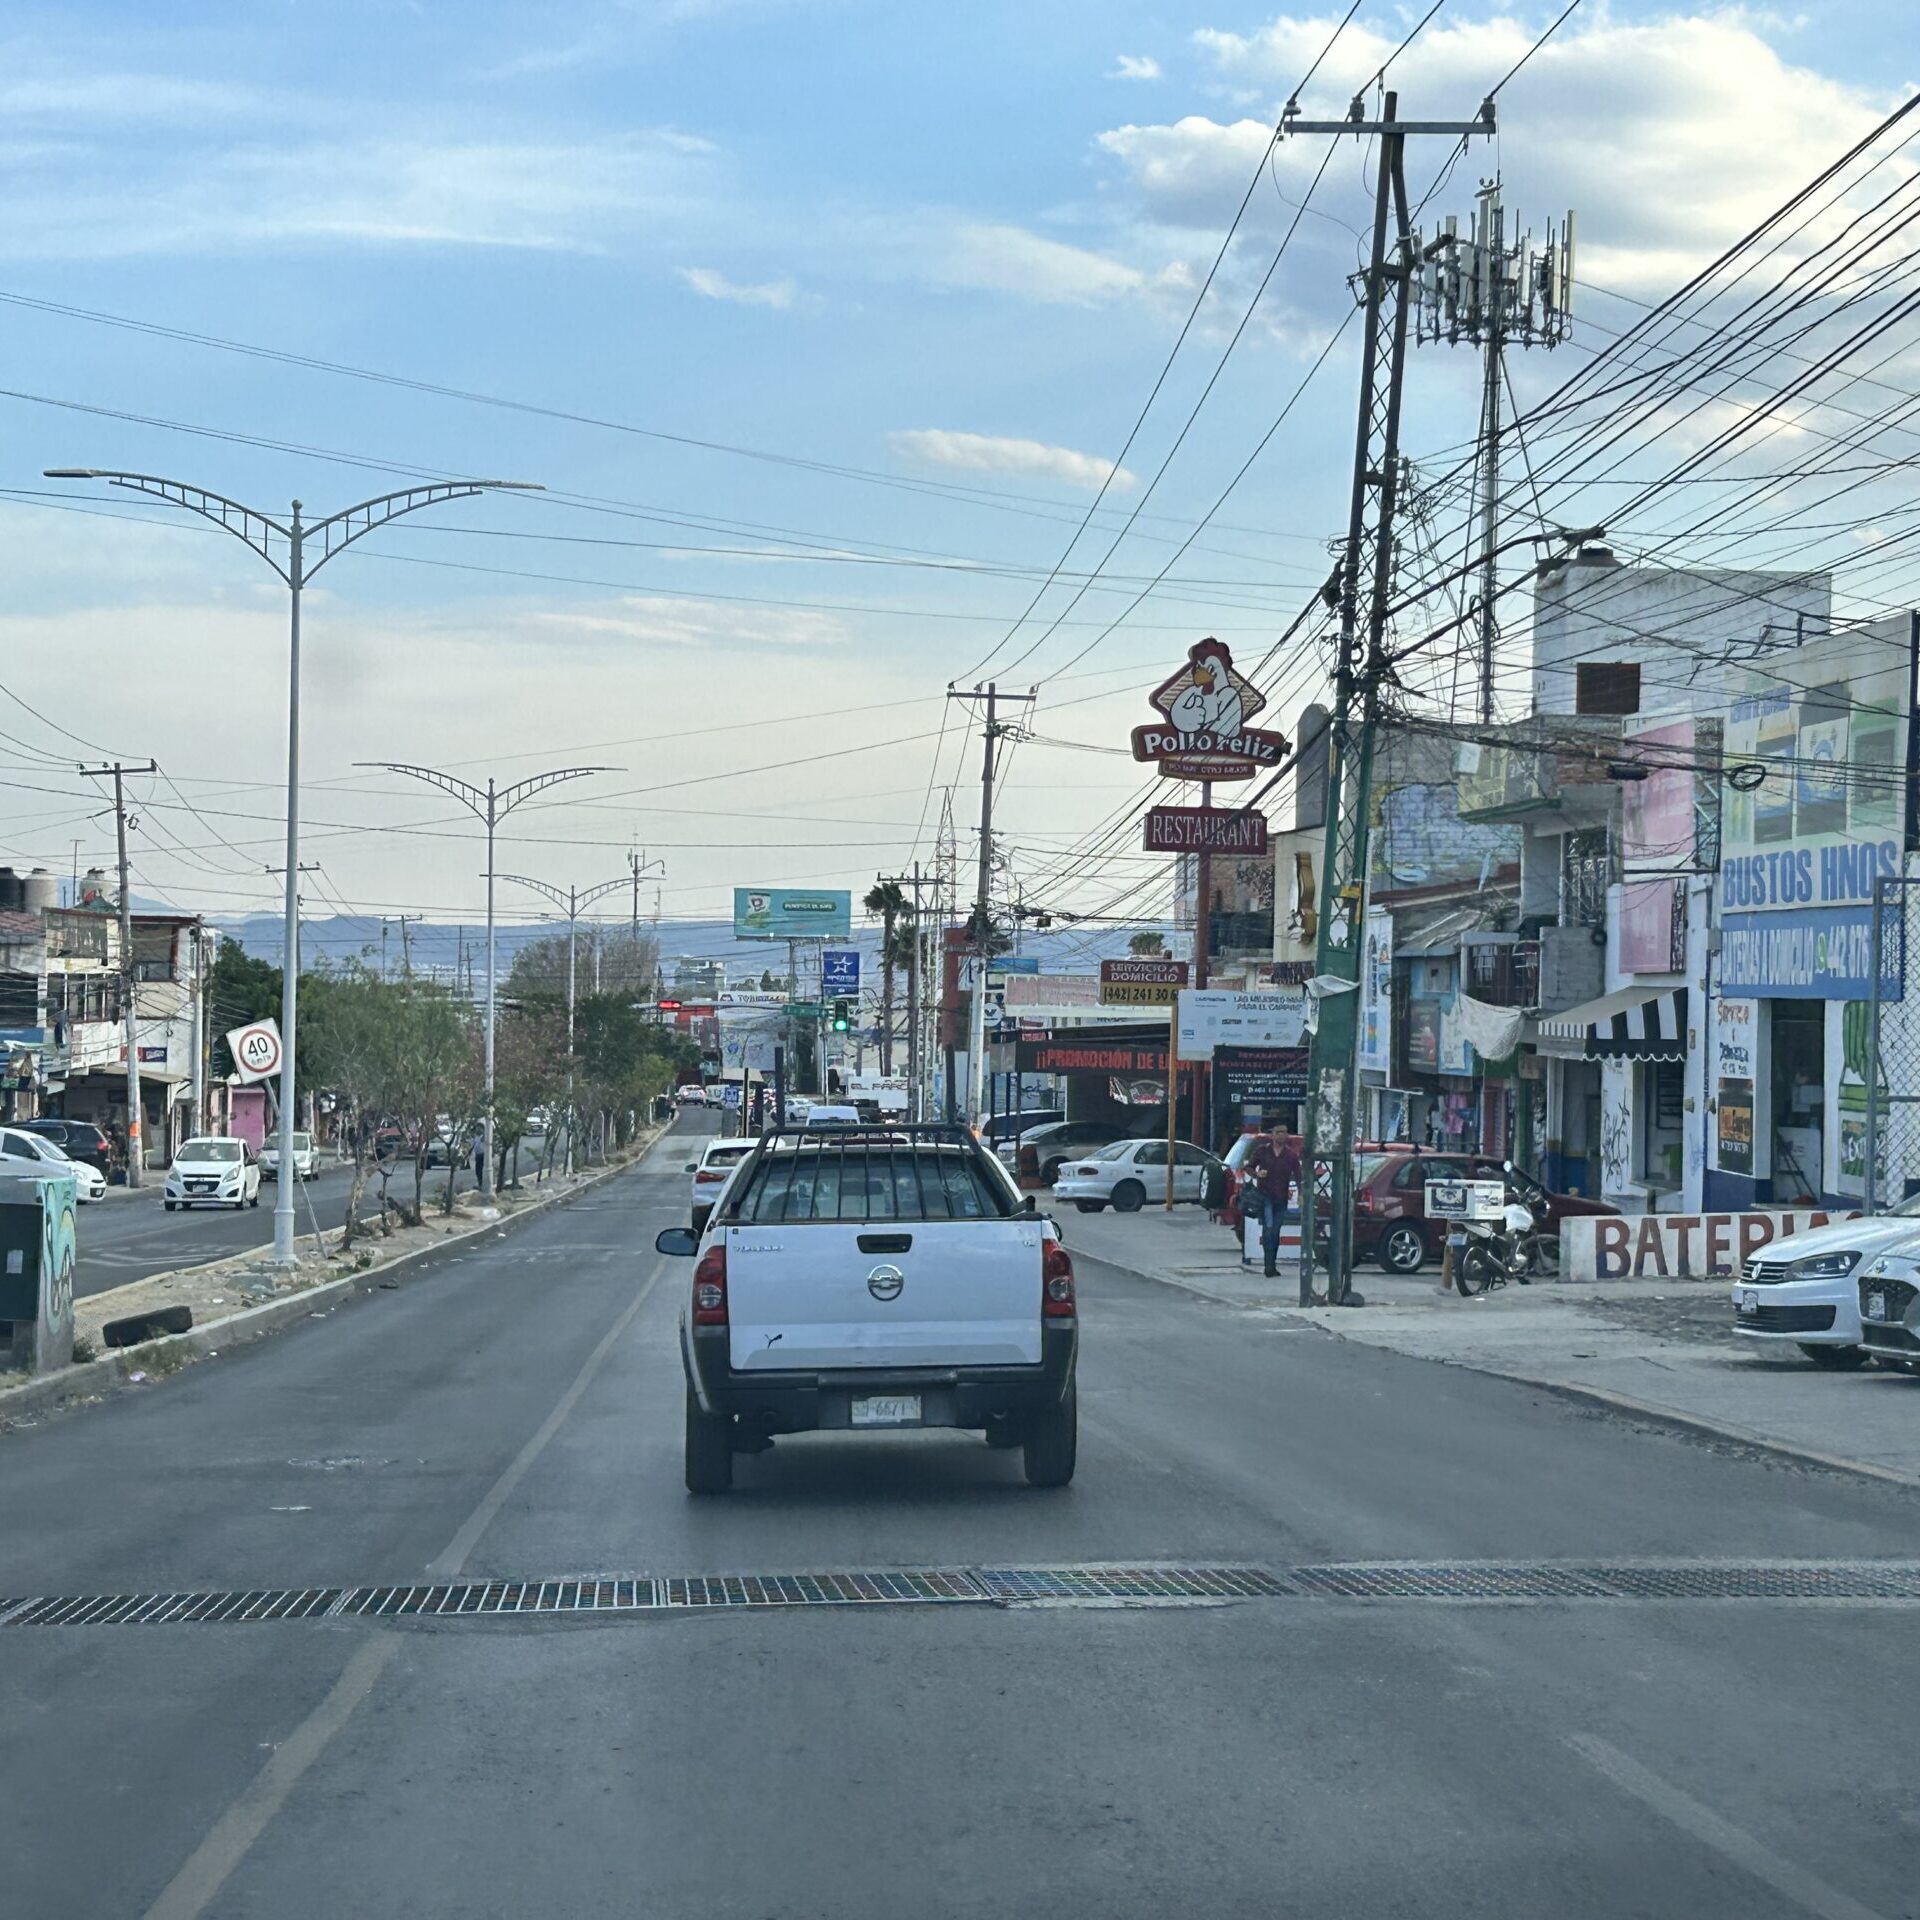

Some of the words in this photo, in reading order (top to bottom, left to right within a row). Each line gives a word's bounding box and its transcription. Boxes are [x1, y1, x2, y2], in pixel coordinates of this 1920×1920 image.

[1143, 731, 1211, 755] Pollo
[1152, 815, 1263, 847] RESTAURANT
[1722, 849, 1813, 908] BUSTOS
[1820, 840, 1897, 901] HNOS
[1109, 963, 1167, 973] SERVICIO
[1169, 964, 1180, 973] A
[1110, 972, 1178, 982] DOMICILIO
[1133, 988, 1151, 1000] 241
[1155, 988, 1169, 1001] 30
[248, 1037, 268, 1056] 40
[1137, 1053, 1154, 1070] DE
[1595, 1210, 1865, 1280] BATER
